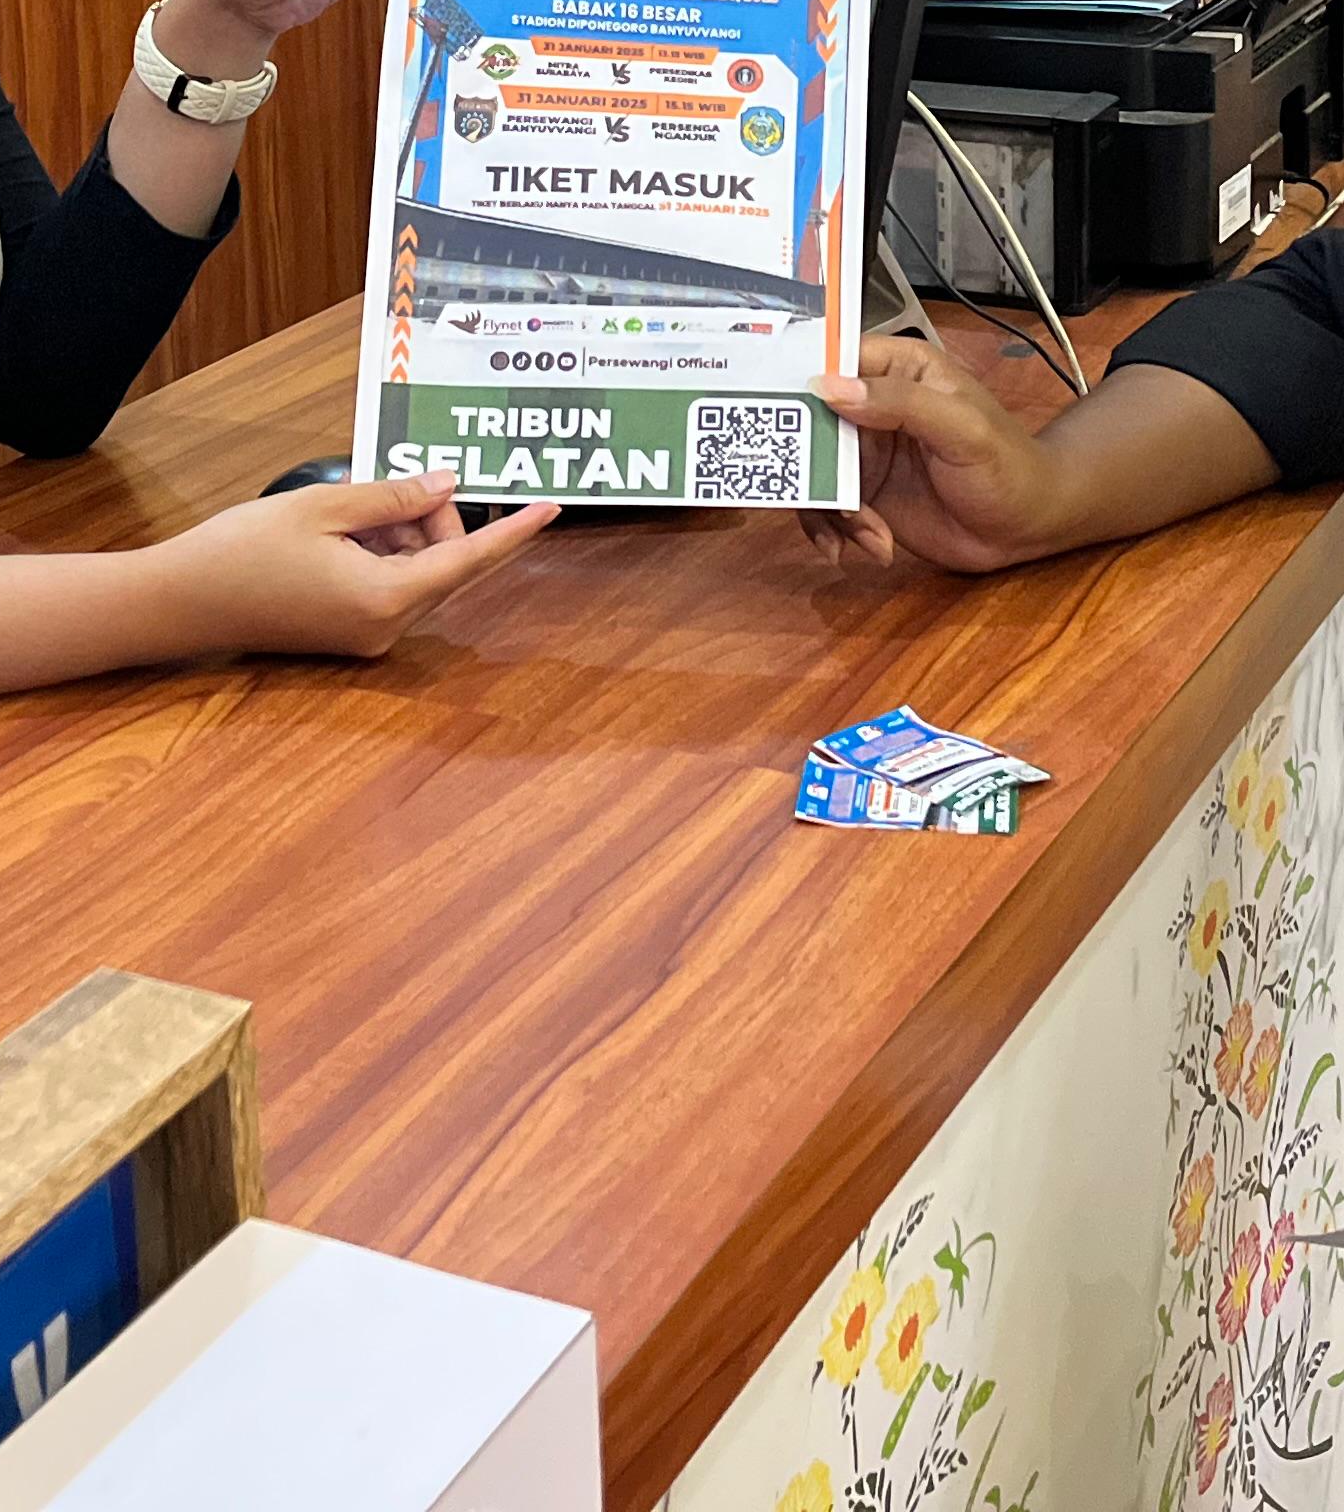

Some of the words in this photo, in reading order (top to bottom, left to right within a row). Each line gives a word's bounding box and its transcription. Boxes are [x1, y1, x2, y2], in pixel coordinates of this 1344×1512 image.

[619, 2, 640, 20] 16
[641, 4, 703, 24] BESAR
[511, 13, 566, 29] STADION
[567, 17, 649, 35] DIPONEGORO
[558, 42, 614, 55] JANUARI
[611, 62, 632, 85] VS
[516, 92, 532, 104] 31
[536, 93, 607, 107] JANUARI
[611, 97, 648, 110] 2025
[698, 102, 727, 113] WIB
[506, 114, 594, 126] PERSEWANGI
[605, 115, 630, 142] VS
[651, 121, 721, 134] PERSENGA
[654, 131, 717, 142] NGANJUK
[485, 165, 598, 194] TIKET
[609, 168, 755, 202] MASUK
[675, 202, 736, 215] JANUARI
[738, 206, 770, 218] 2025
[483, 318, 522, 332] Flynet
[588, 356, 672, 371] Persewangi
[677, 356, 728, 370] Official
[450, 407, 612, 439] TRIBUN
[386, 442, 670, 491] SELATAN
